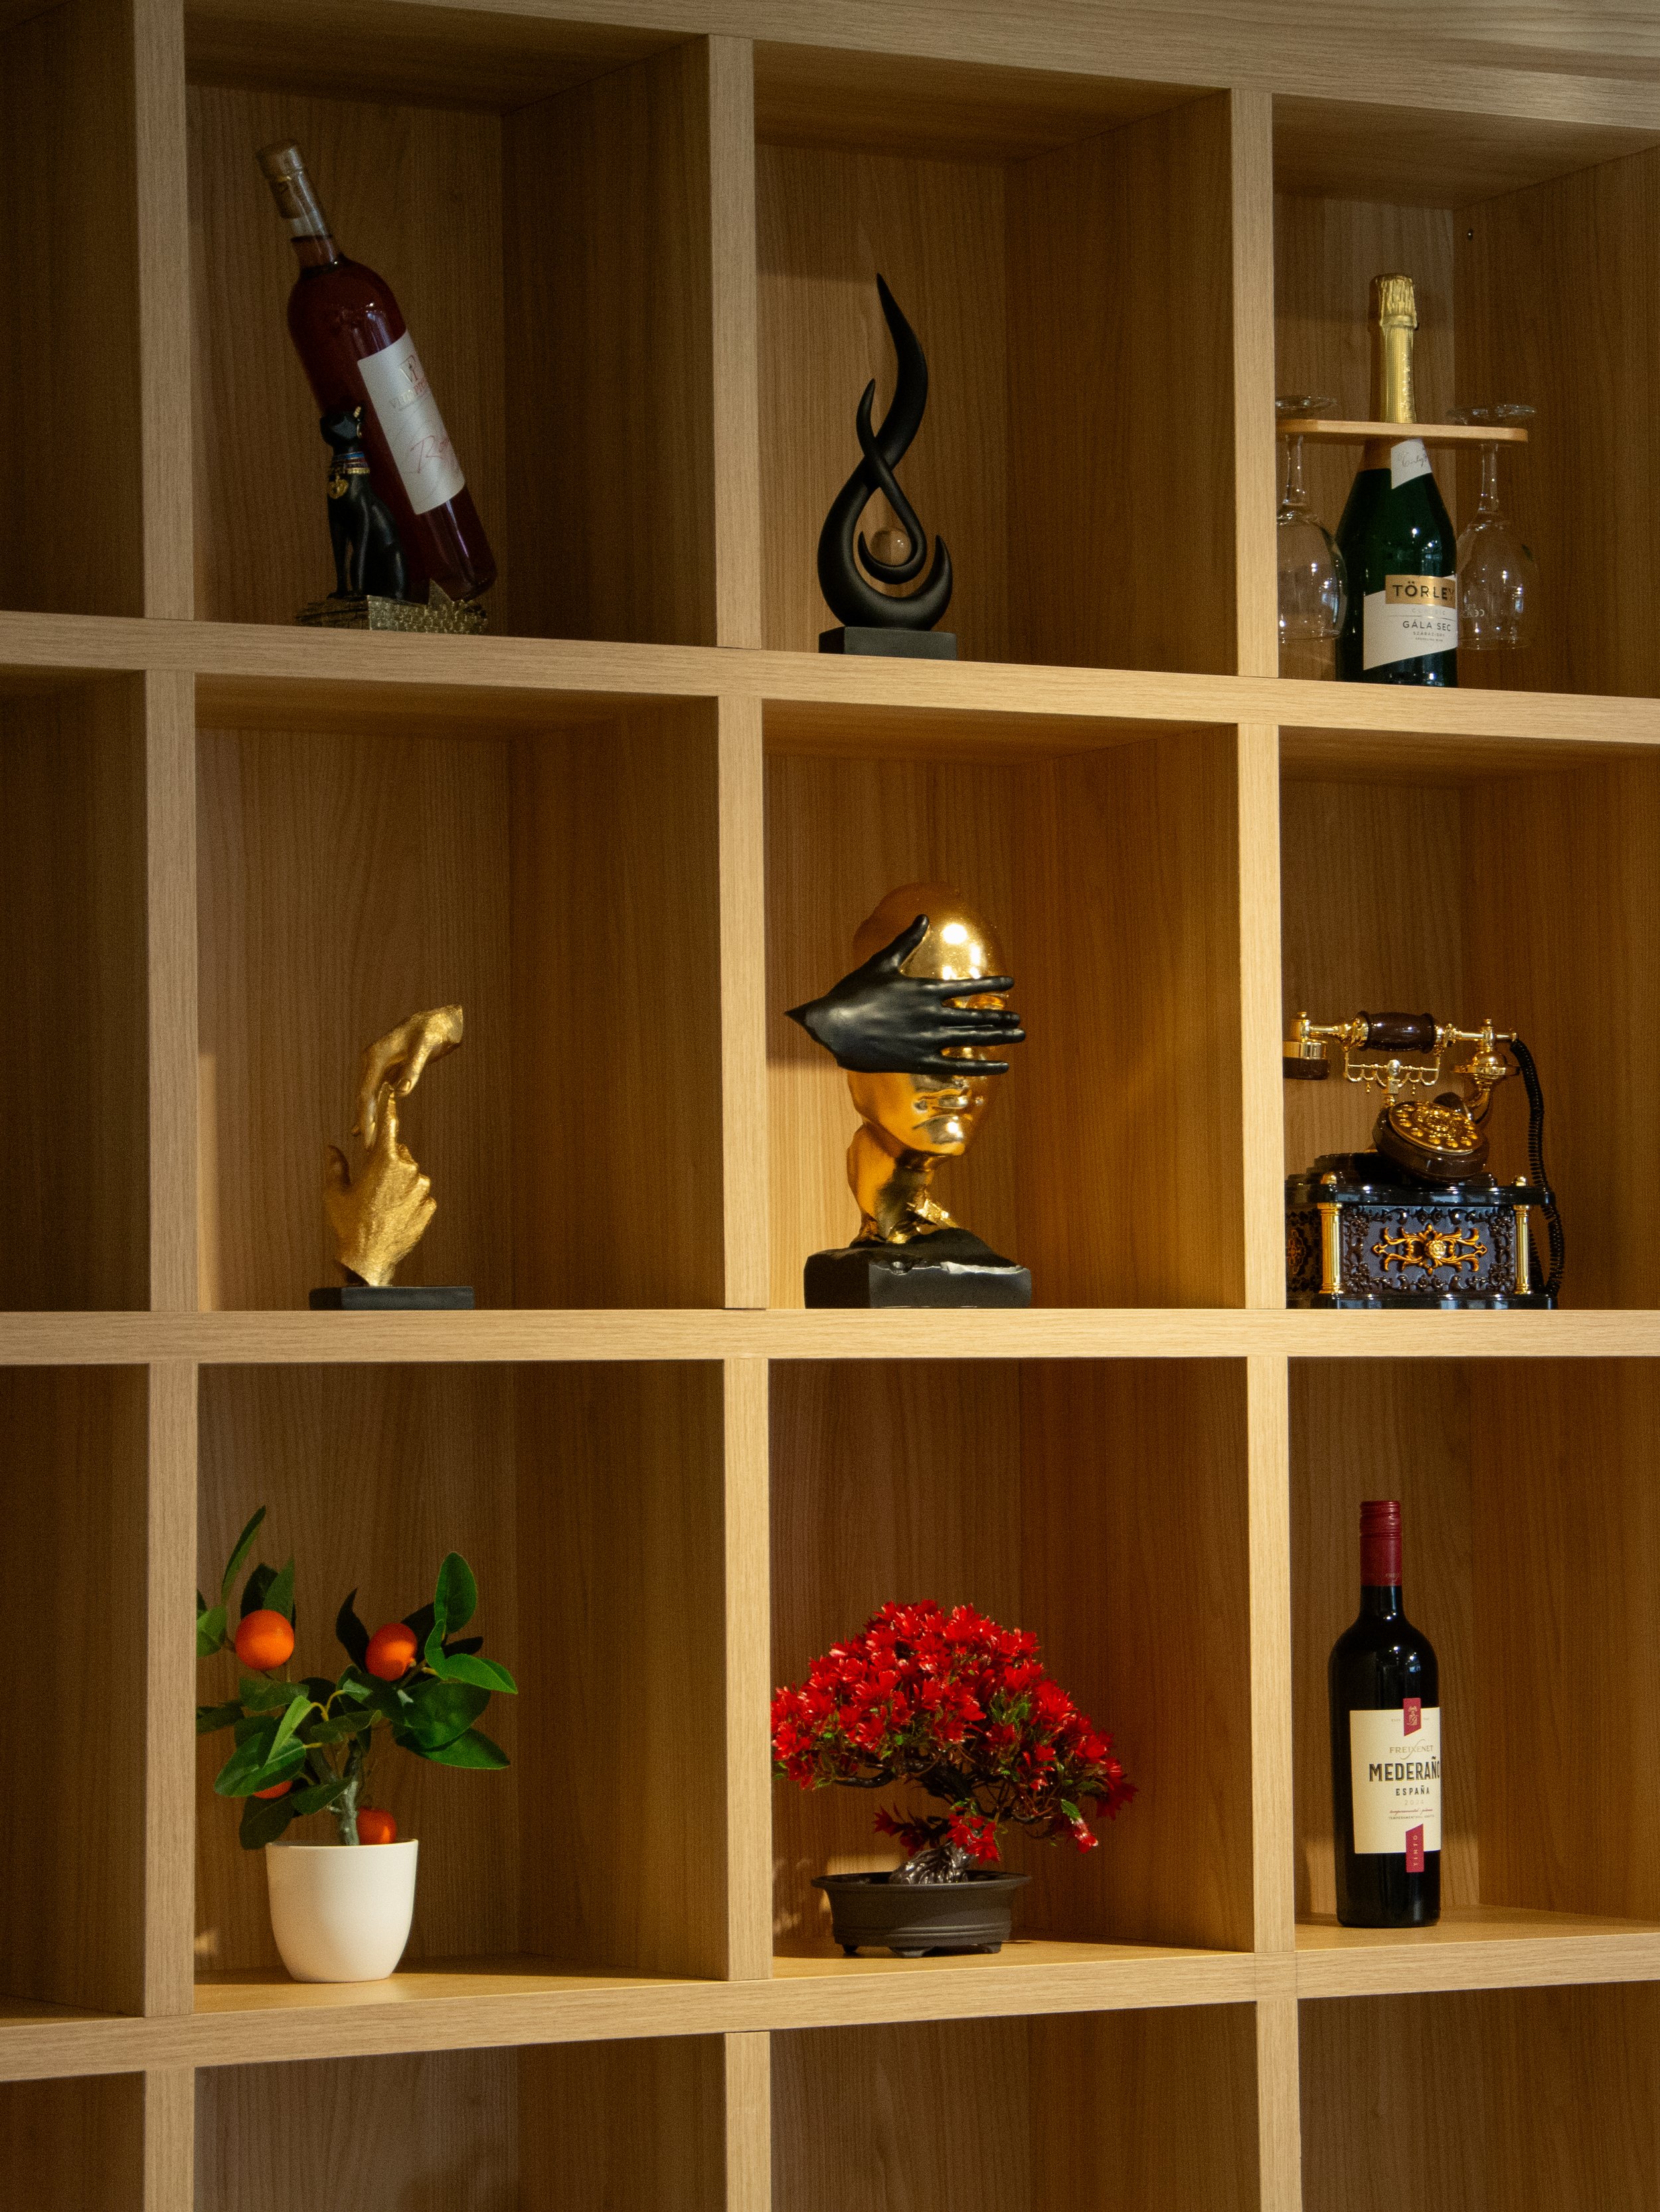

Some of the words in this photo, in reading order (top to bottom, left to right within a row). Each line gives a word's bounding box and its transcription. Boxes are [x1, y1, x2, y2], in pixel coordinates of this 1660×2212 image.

[1402, 619, 1432, 629] GÁLA
[1436, 622, 1452, 632] SEC
[1395, 1784, 1430, 1796] ESPAÑA
